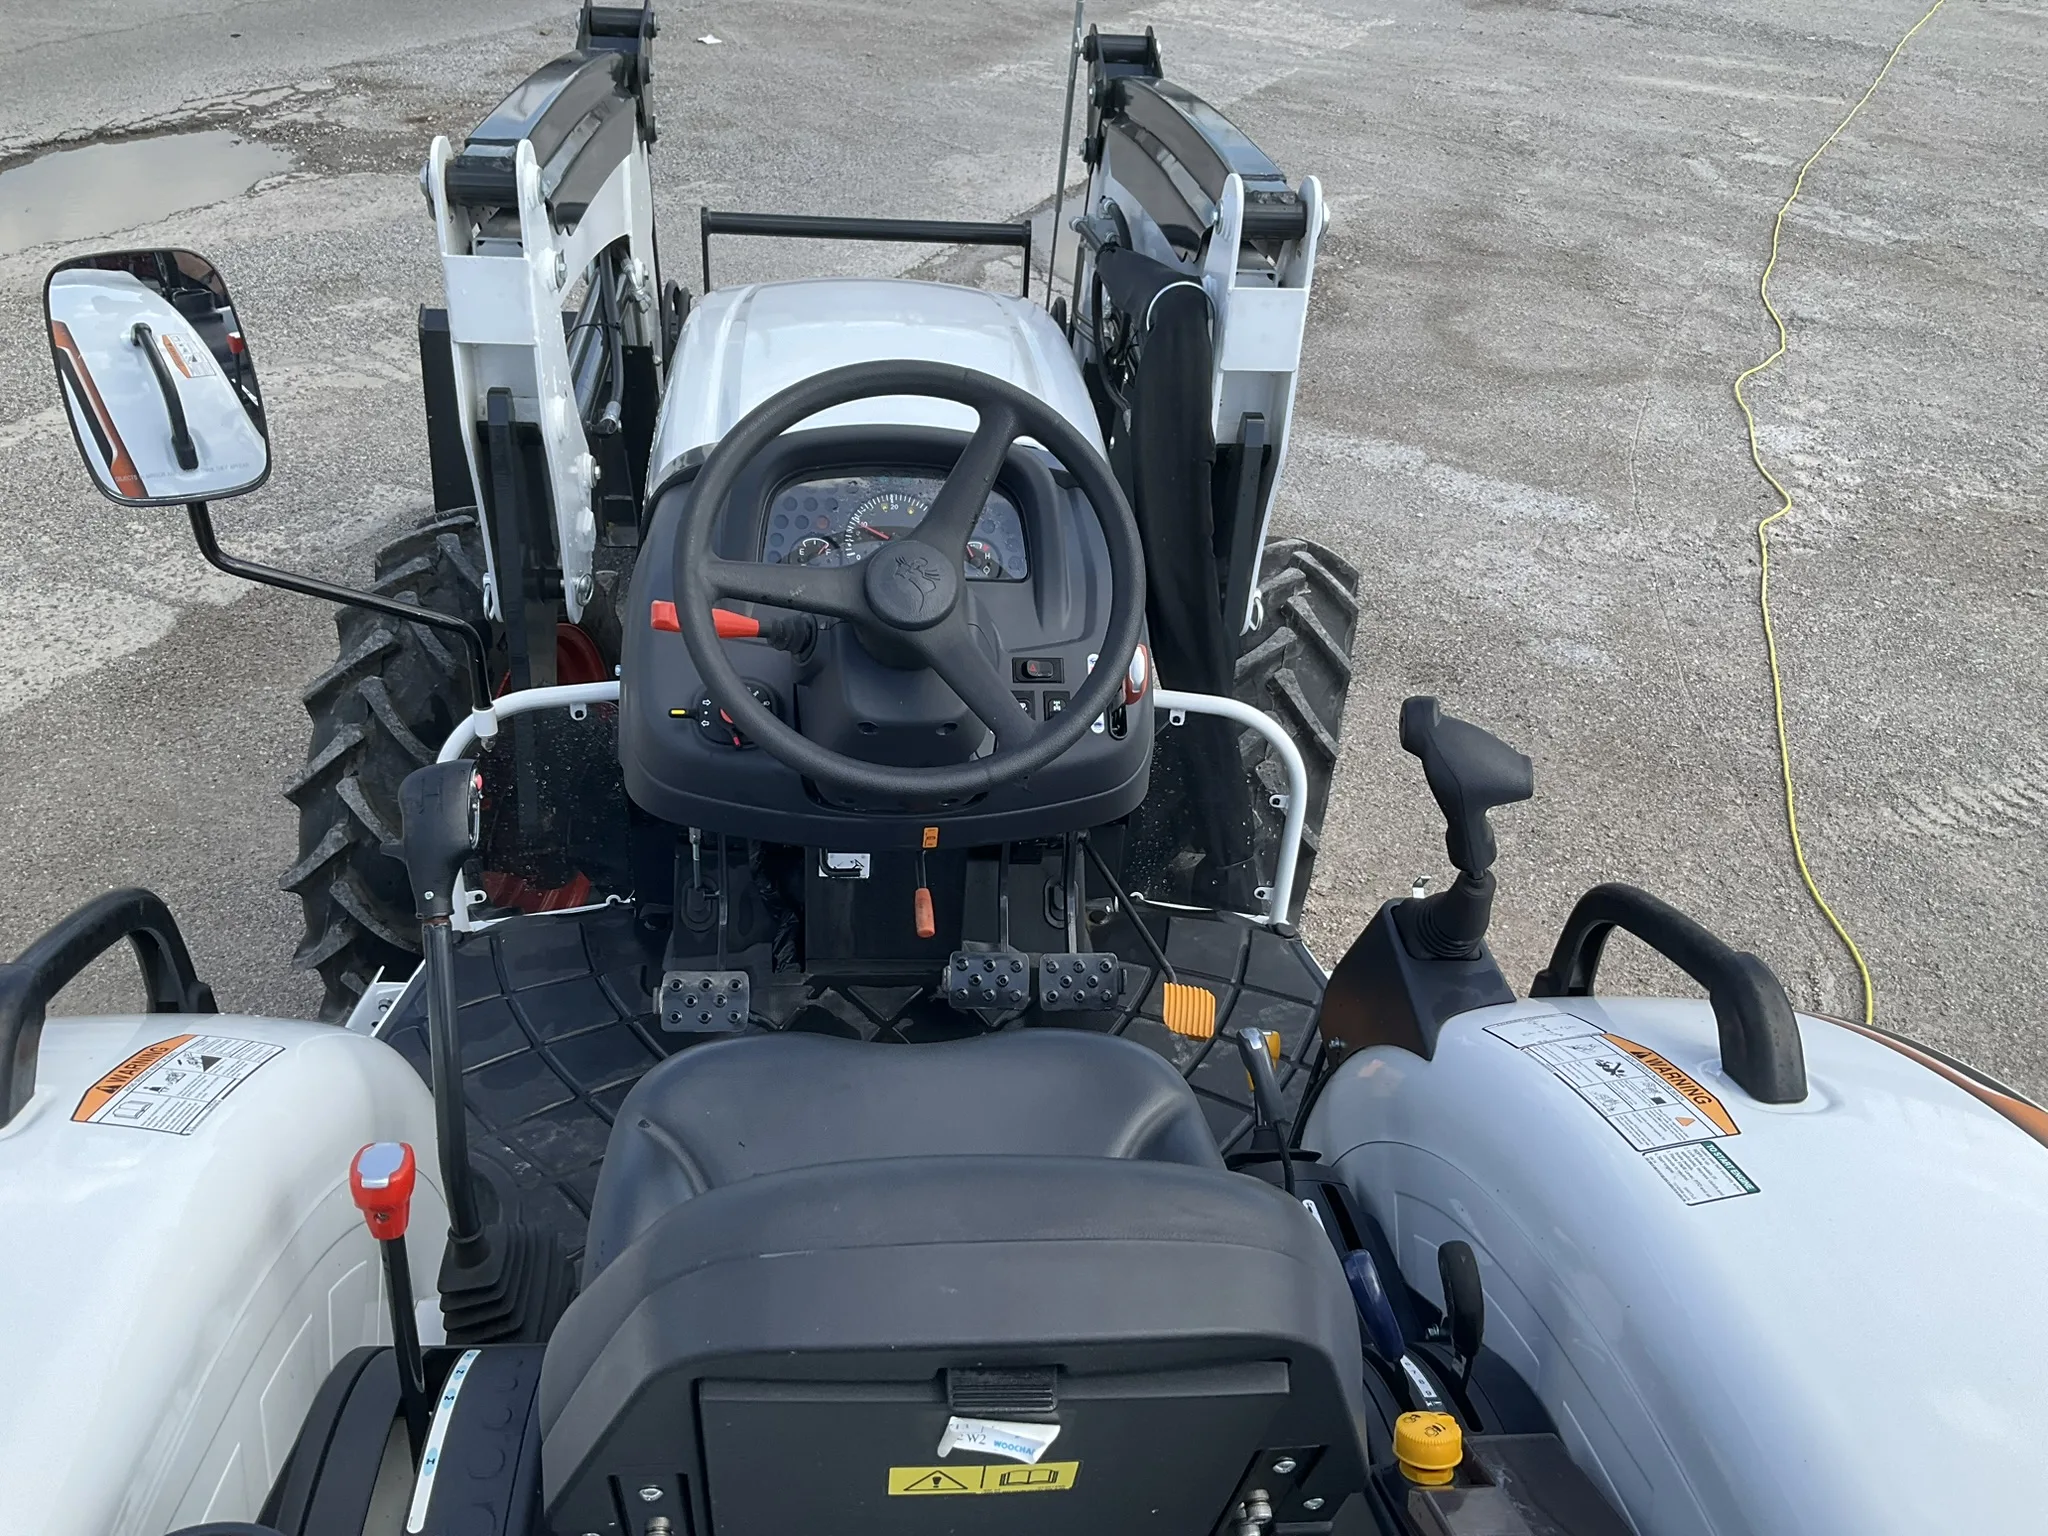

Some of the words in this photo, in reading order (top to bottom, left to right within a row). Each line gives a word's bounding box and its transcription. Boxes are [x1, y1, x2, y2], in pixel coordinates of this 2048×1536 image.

[799, 548, 805, 556] E
[984, 552, 991, 560] H
[105, 1047, 170, 1083] WARNING
[1645, 1057, 1713, 1105] WARNING
[1706, 1144, 1716, 1152] TO
[1714, 1150, 1733, 1171] START
[1731, 1168, 1756, 1191] ENGINE
[426, 1458, 436, 1466] H
